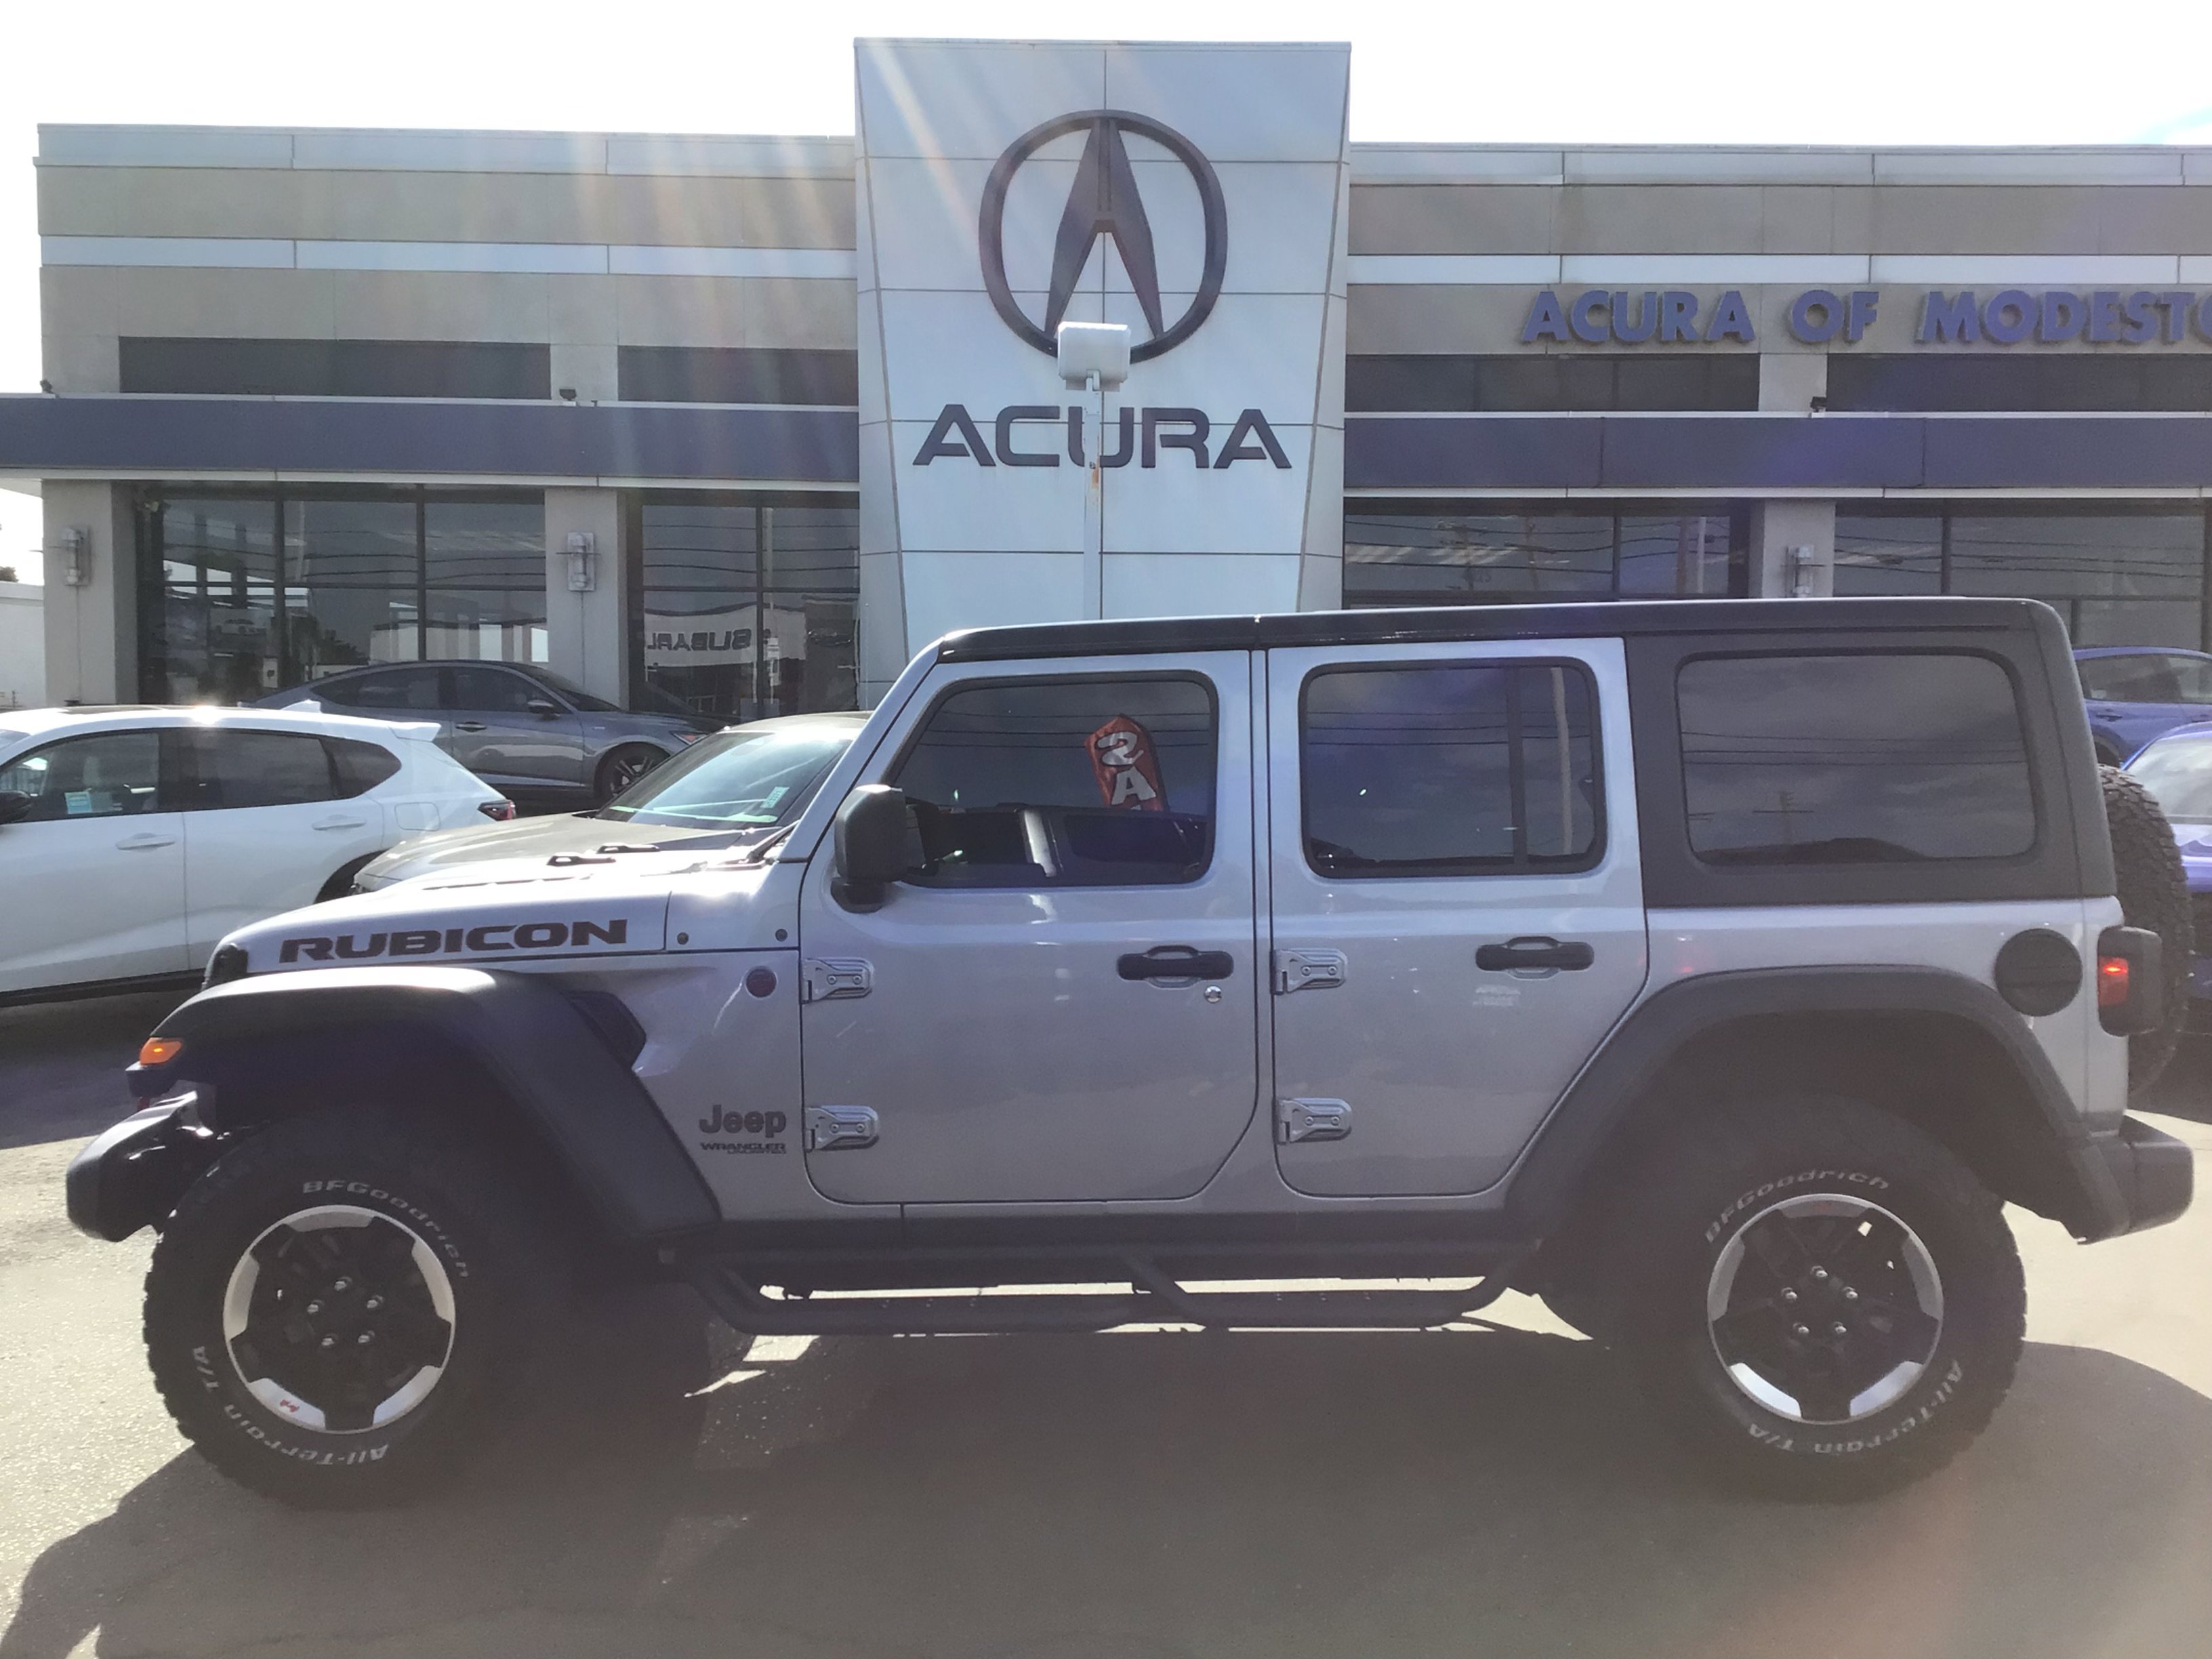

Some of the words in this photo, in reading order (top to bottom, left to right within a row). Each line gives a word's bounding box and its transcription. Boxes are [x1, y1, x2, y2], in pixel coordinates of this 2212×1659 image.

[1521, 289, 1755, 342] ACURA
[1790, 289, 1879, 342] OF
[912, 404, 1292, 469] ACURA
[279, 919, 628, 963] RUBICON
[699, 1104, 786, 1138] Jeep
